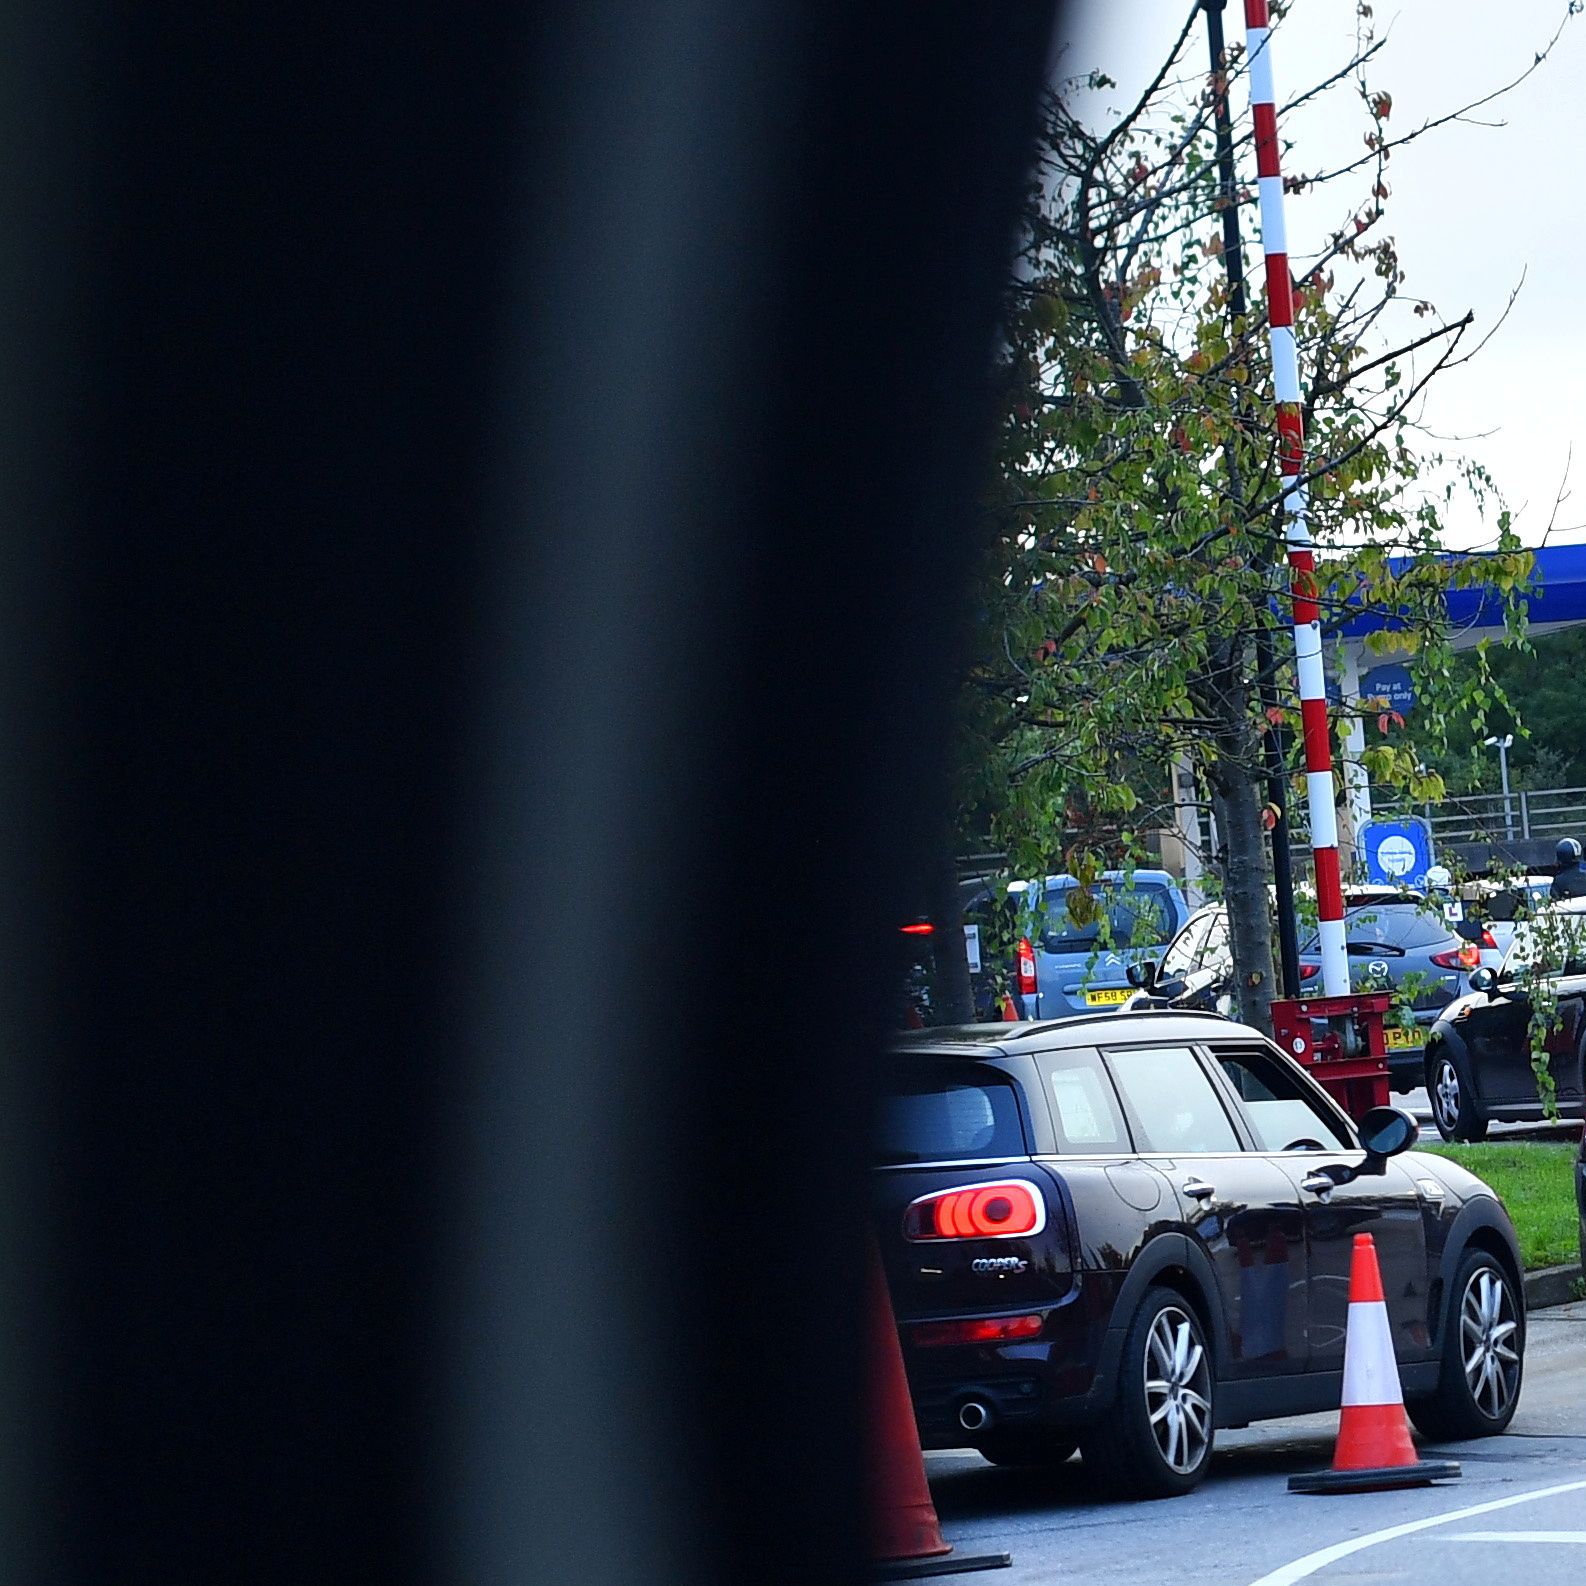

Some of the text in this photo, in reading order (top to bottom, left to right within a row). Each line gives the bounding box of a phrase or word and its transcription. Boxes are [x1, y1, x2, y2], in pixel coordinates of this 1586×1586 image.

[1375, 682, 1402, 692] Pay at
[1393, 692, 1411, 701] only
